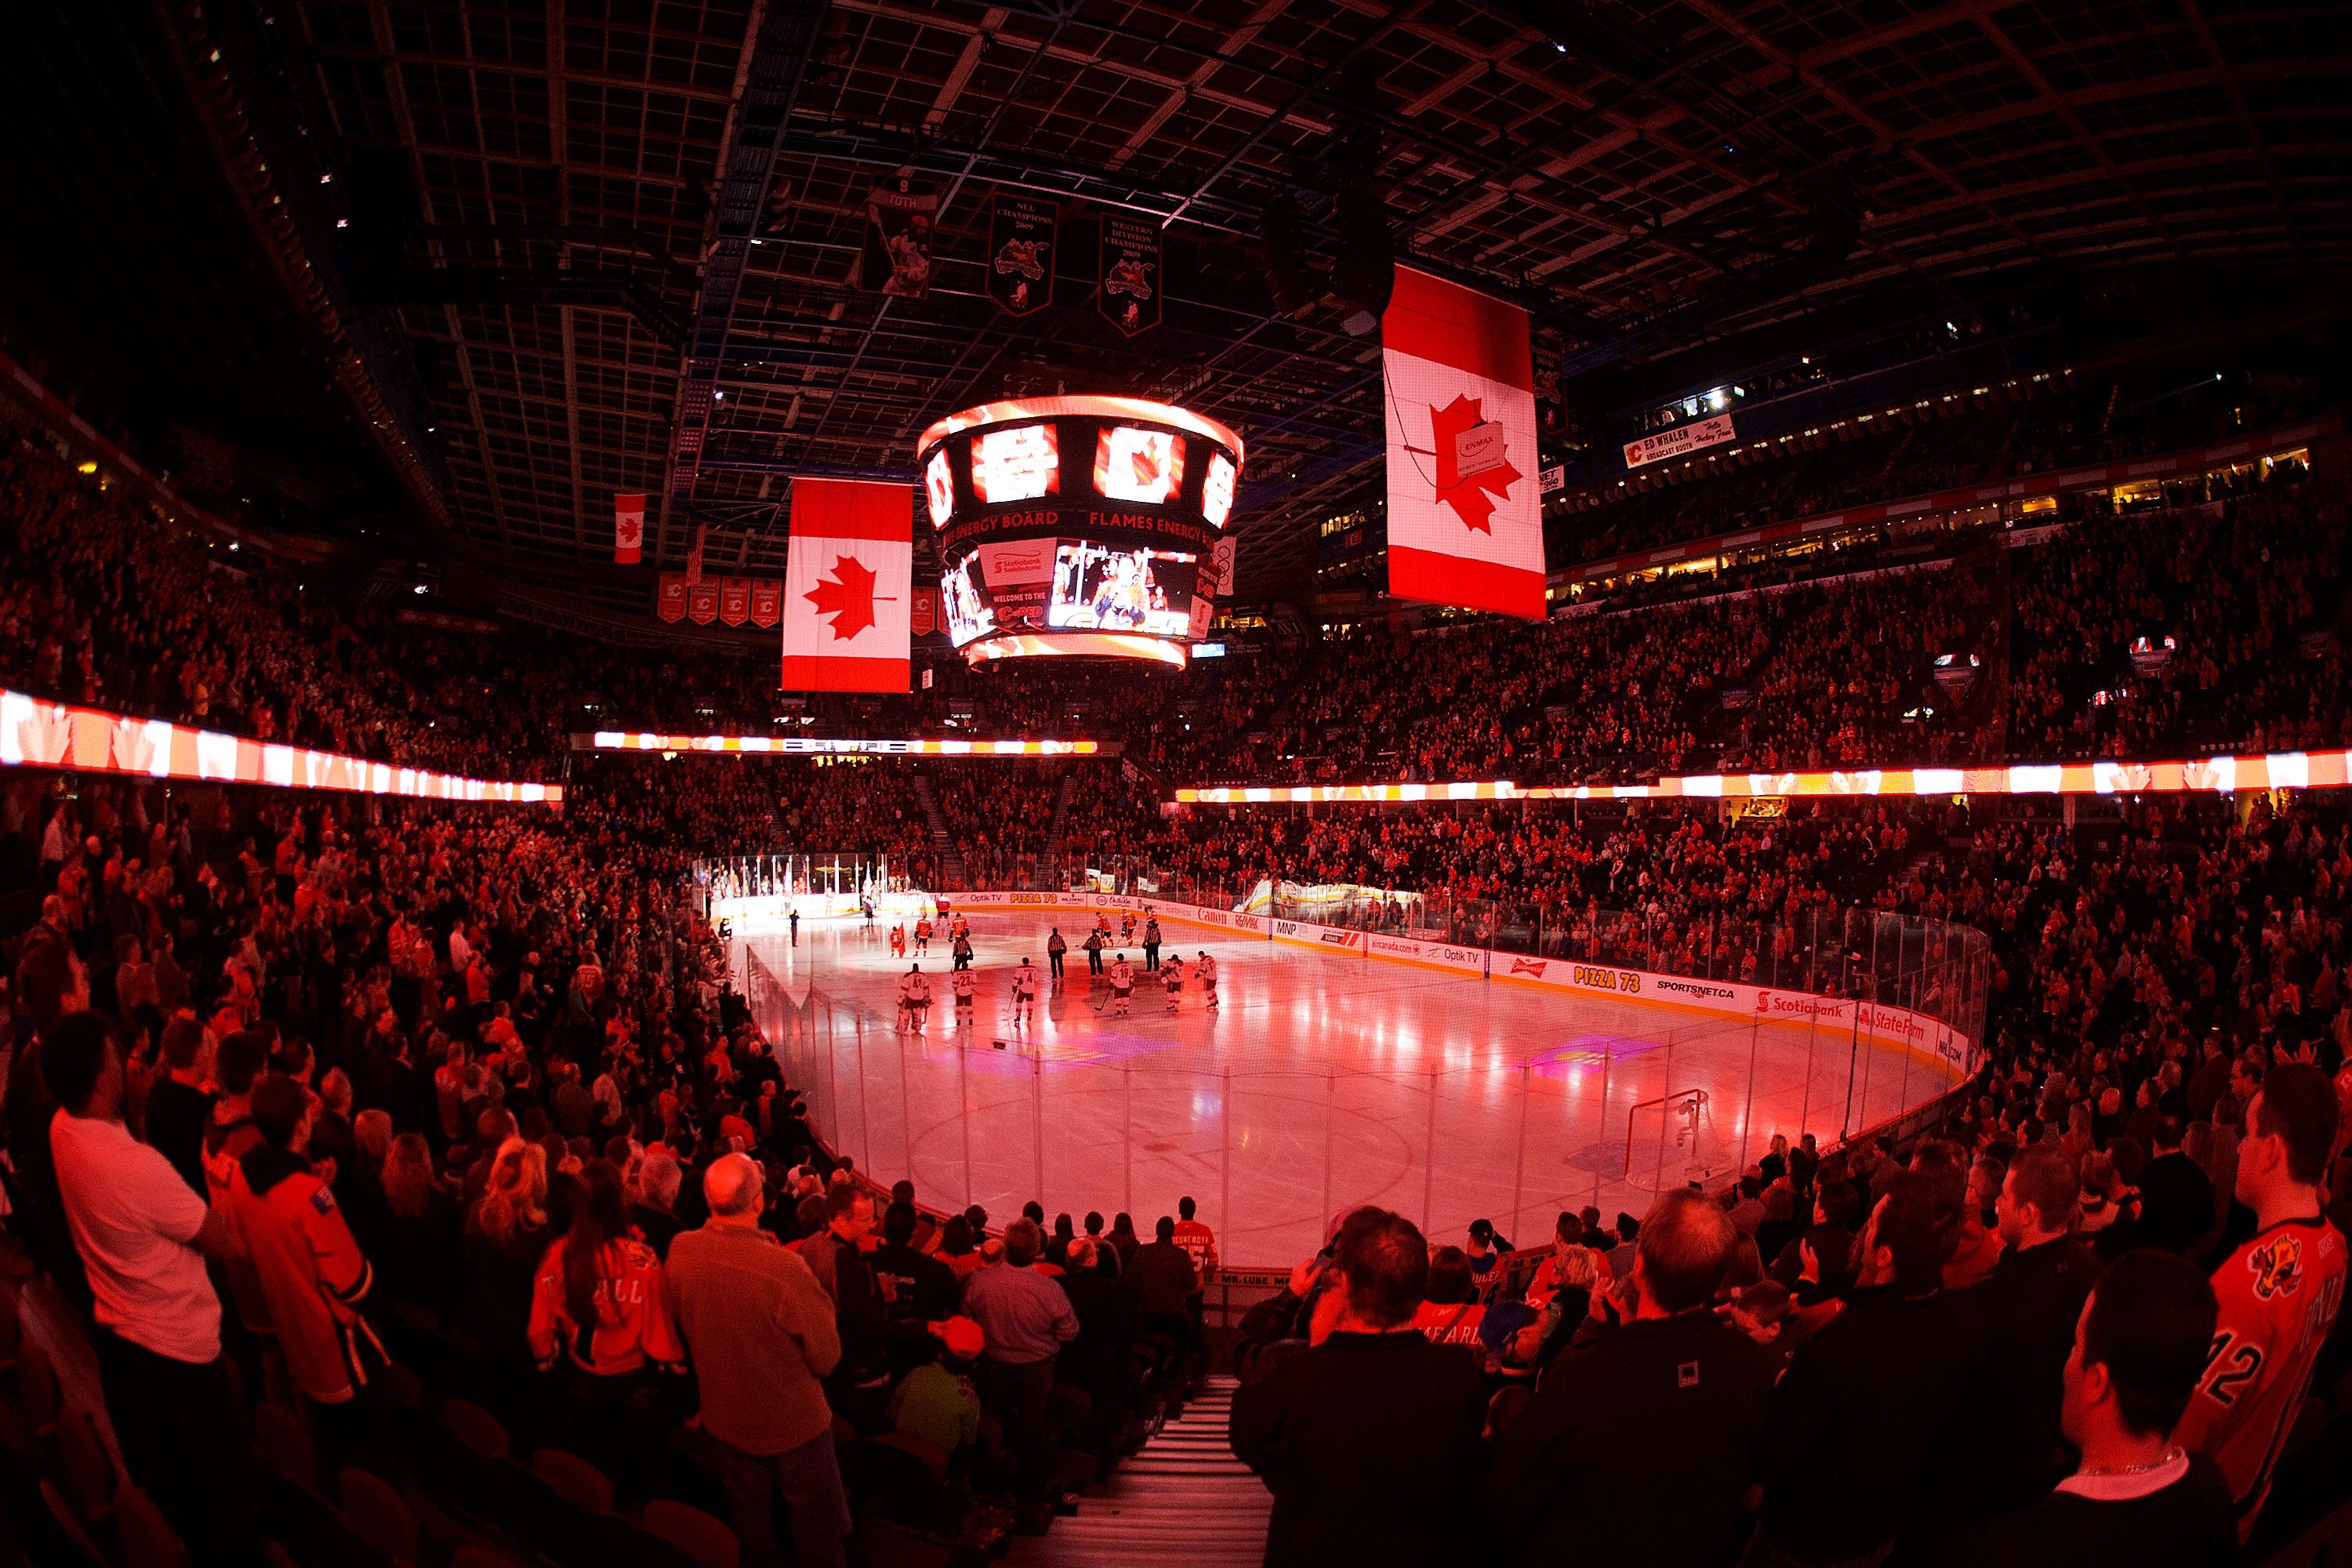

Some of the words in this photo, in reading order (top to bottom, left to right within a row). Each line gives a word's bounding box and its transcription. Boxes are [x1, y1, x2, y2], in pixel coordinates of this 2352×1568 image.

[899, 180, 909, 192] 9
[888, 194, 917, 209] TOTH
[996, 207, 1054, 225] CHAMPIONS
[1014, 220, 1034, 230] 2009
[1111, 220, 1153, 235] WESTERN
[1112, 228, 1152, 244] DIVISION
[1105, 235, 1158, 254] CHAMPIONS
[1122, 249, 1141, 259] 2009
[1465, 437, 1494, 450] ENMAX
[1644, 439, 1655, 451] ED
[1656, 428, 1690, 447] WHALEN
[1646, 446, 1675, 461] BROADCAST
[1675, 442, 1693, 452] BOOTH
[1544, 477, 1559, 488] 960
[955, 515, 999, 540] ENERGY
[1002, 510, 1058, 528] BOARD
[1089, 511, 1153, 530] FLAMES
[1156, 517, 1201, 541] ENERGY
[1004, 557, 1042, 567] Scotiabank
[1004, 564, 1042, 573] Saddledome
[993, 593, 1025, 603] WELCOME
[971, 894, 990, 902] Optik
[1010, 893, 1041, 903] PIZZA
[1044, 893, 1058, 904] 73
[1197, 908, 1228, 925] Canon
[1235, 914, 1259, 930] RE/MAX
[1276, 921, 1297, 935] MNP
[1372, 939, 1412, 953] aircanada.com
[1444, 948, 1465, 961] Optik
[1467, 951, 1479, 964] TV
[1120, 967, 1129, 979] 19
[1512, 958, 1543, 974] Budweiser
[913, 977, 923, 989] 41
[959, 975, 971, 987] 23
[1027, 971, 1033, 983] 4
[1573, 965, 1617, 989] PIZZA
[1620, 972, 1640, 993] 73
[1657, 980, 1735, 1000] SPORTSNET.CA
[1773, 997, 1842, 1018] Scotiabank
[1243, 1276, 1269, 1285] LUBE
